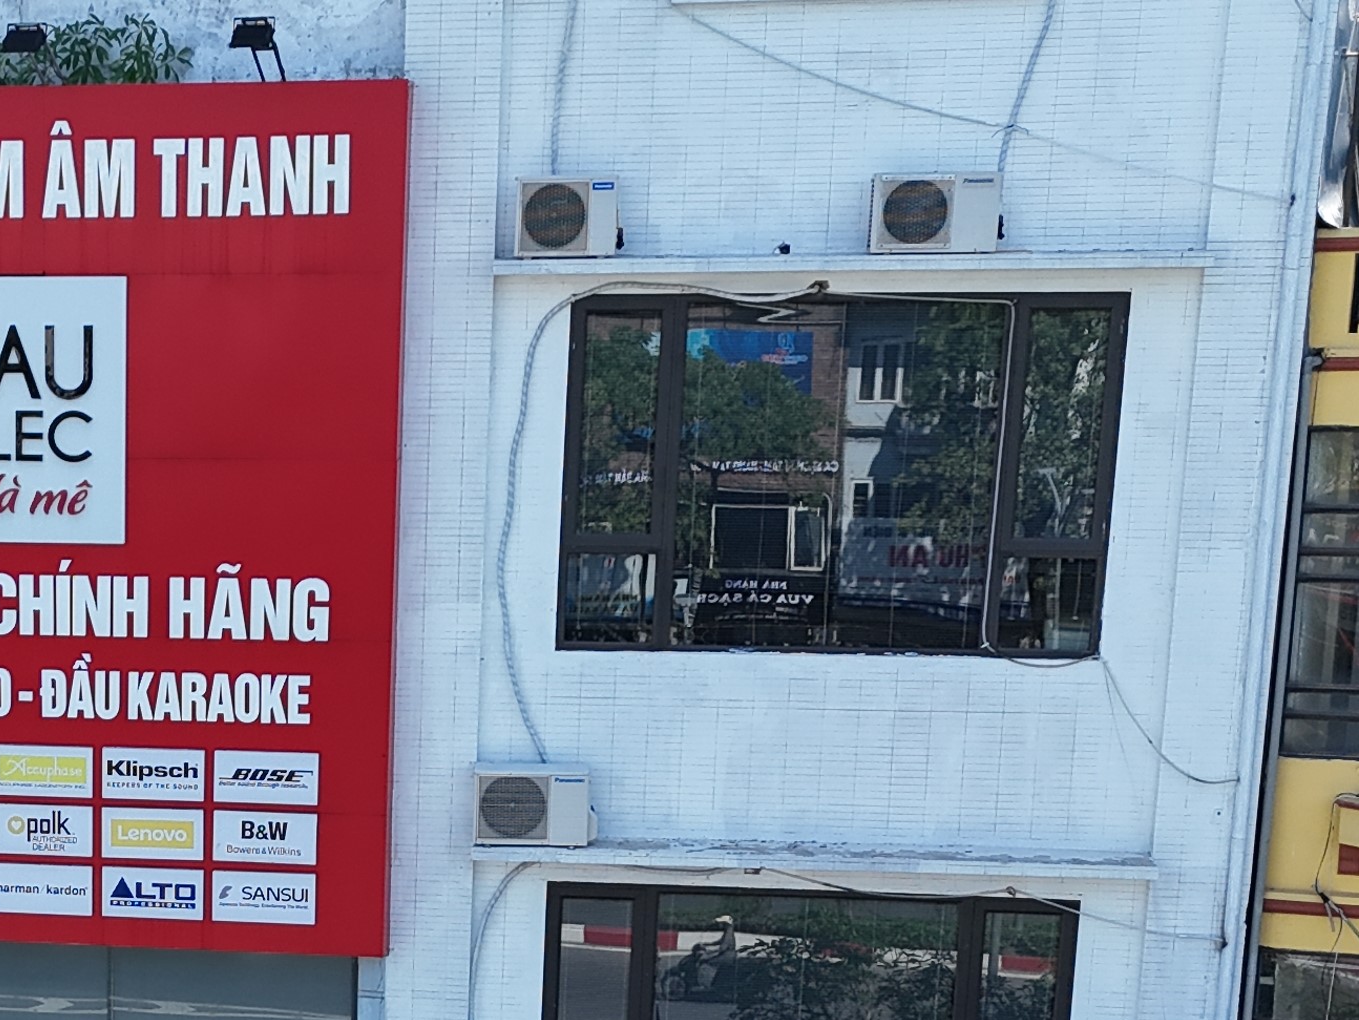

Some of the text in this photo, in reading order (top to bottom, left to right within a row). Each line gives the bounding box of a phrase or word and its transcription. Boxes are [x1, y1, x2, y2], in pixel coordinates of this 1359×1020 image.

[42, 120, 135, 219] ÂM
[153, 134, 350, 217] THANH
[29, 479, 92, 518] mê
[169, 563, 330, 642] HÃNG
[40, 652, 120, 720] ĐẦU
[127, 671, 311, 725] KARAOKE
[2, 757, 82, 782] Accuphase
[106, 760, 199, 781] Klipsch
[227, 768, 308, 782] BOSE
[27, 810, 71, 842] polk
[117, 825, 187, 842] Lenovo
[241, 820, 288, 841] B&W
[242, 886, 309, 902] SANSUI
